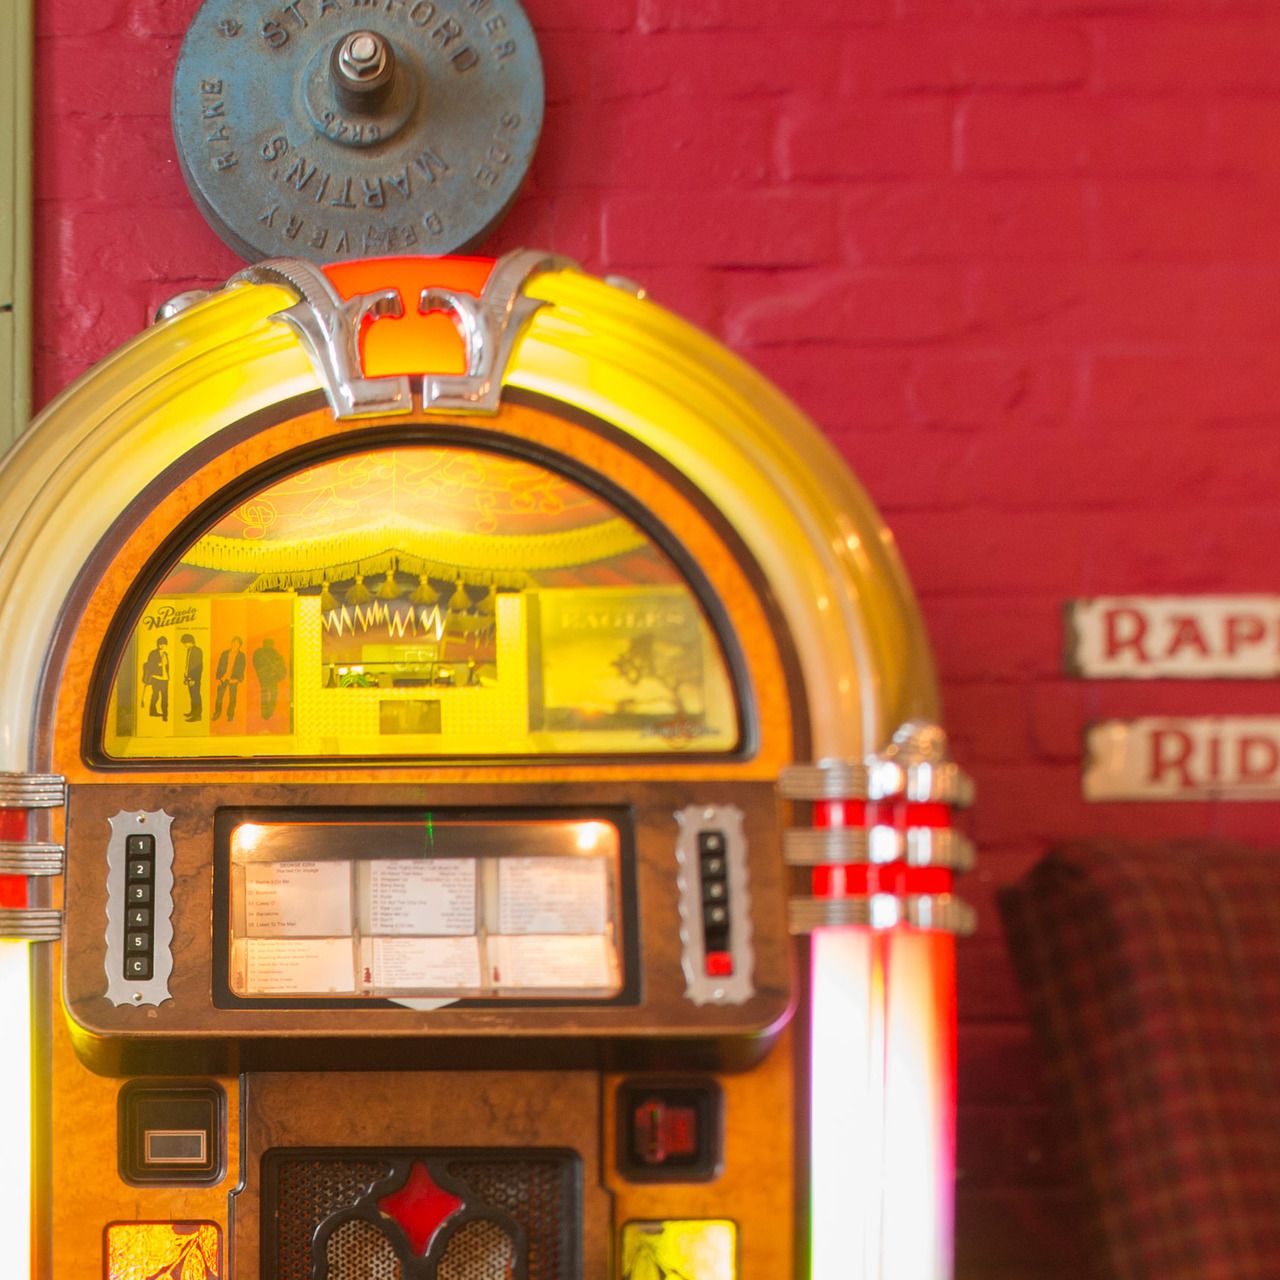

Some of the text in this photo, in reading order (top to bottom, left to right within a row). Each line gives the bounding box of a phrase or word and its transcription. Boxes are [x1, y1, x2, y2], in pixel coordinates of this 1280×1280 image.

[260, 0, 479, 73] STAORD
[475, 111, 522, 186] SIDE
[138, 841, 144, 850] 1
[137, 865, 144, 874] 2
[136, 889, 143, 898] 3
[136, 913, 142, 922] 4
[135, 937, 142, 946] 5
[134, 962, 141, 971] C
